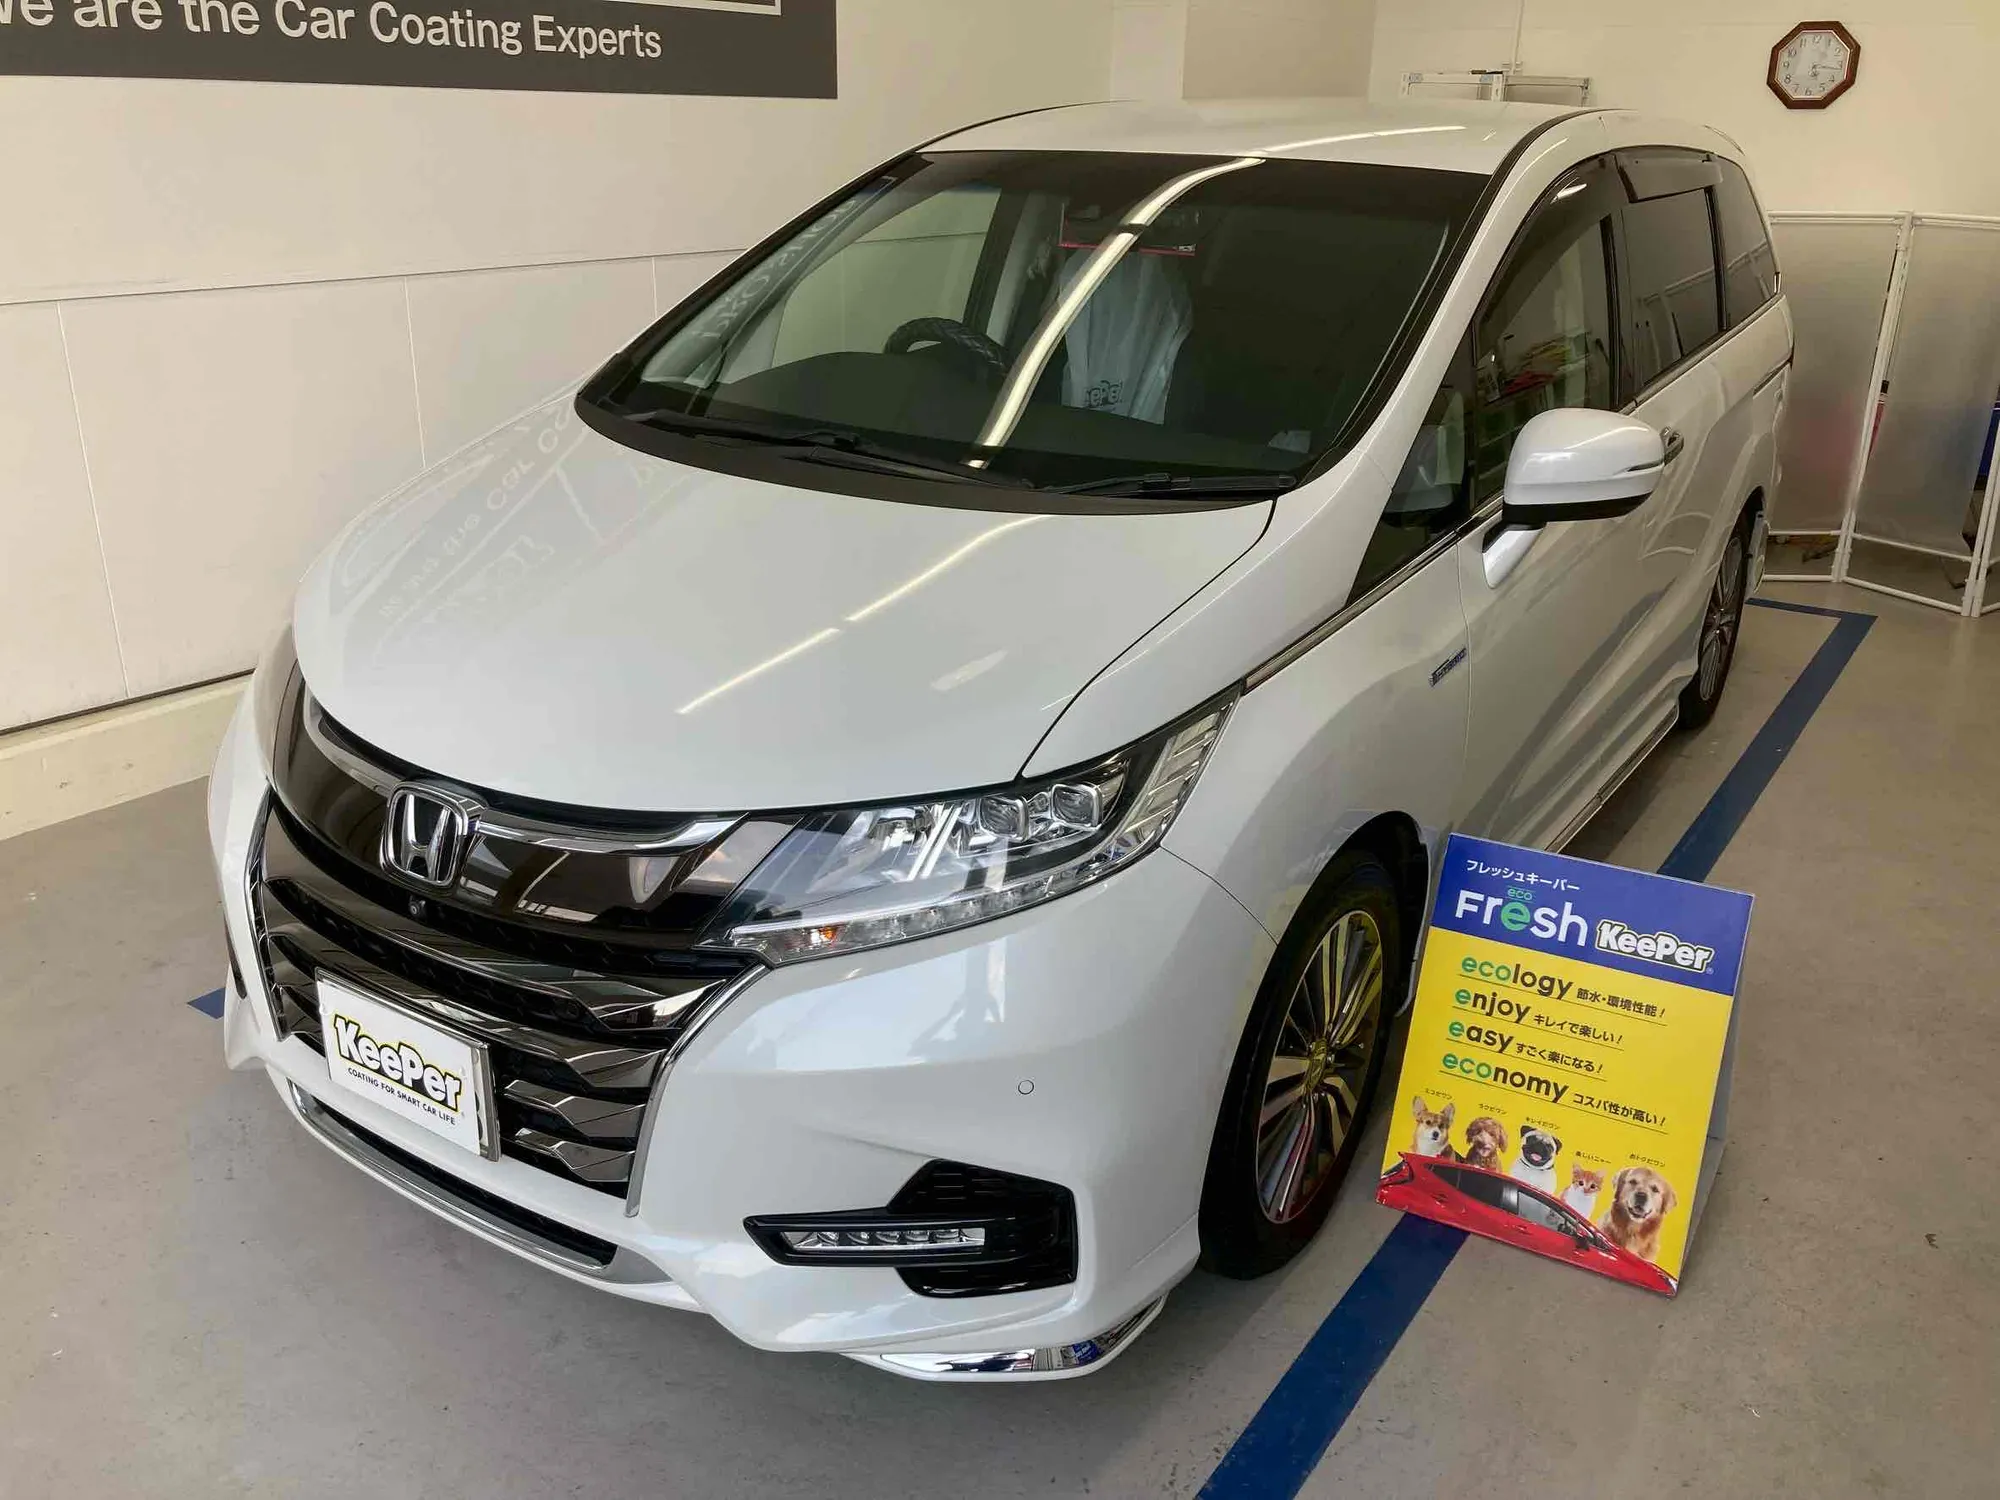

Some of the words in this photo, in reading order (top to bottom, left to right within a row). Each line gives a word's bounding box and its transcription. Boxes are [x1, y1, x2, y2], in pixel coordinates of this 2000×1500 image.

[73, 0, 163, 30] are
[178, 0, 260, 35] the
[275, 0, 355, 39] Car
[369, 1, 523, 55] Coating
[532, 14, 662, 59] Experts
[1507, 887, 1533, 901] eco
[1455, 889, 1589, 948] Fresh
[1596, 919, 1715, 974] KeePer
[1461, 956, 1574, 1000] ecology
[1454, 988, 1532, 1024] enjoy
[334, 1013, 463, 1113] KeePer
[1448, 1020, 1515, 1054] easy
[347, 1066, 380, 1088] COATING
[380, 1081, 396, 1096] FOR
[397, 1090, 421, 1109] SMART
[421, 1103, 438, 1117] CAR
[438, 1110, 456, 1126] LIFE
[1442, 1052, 1570, 1104] economy
